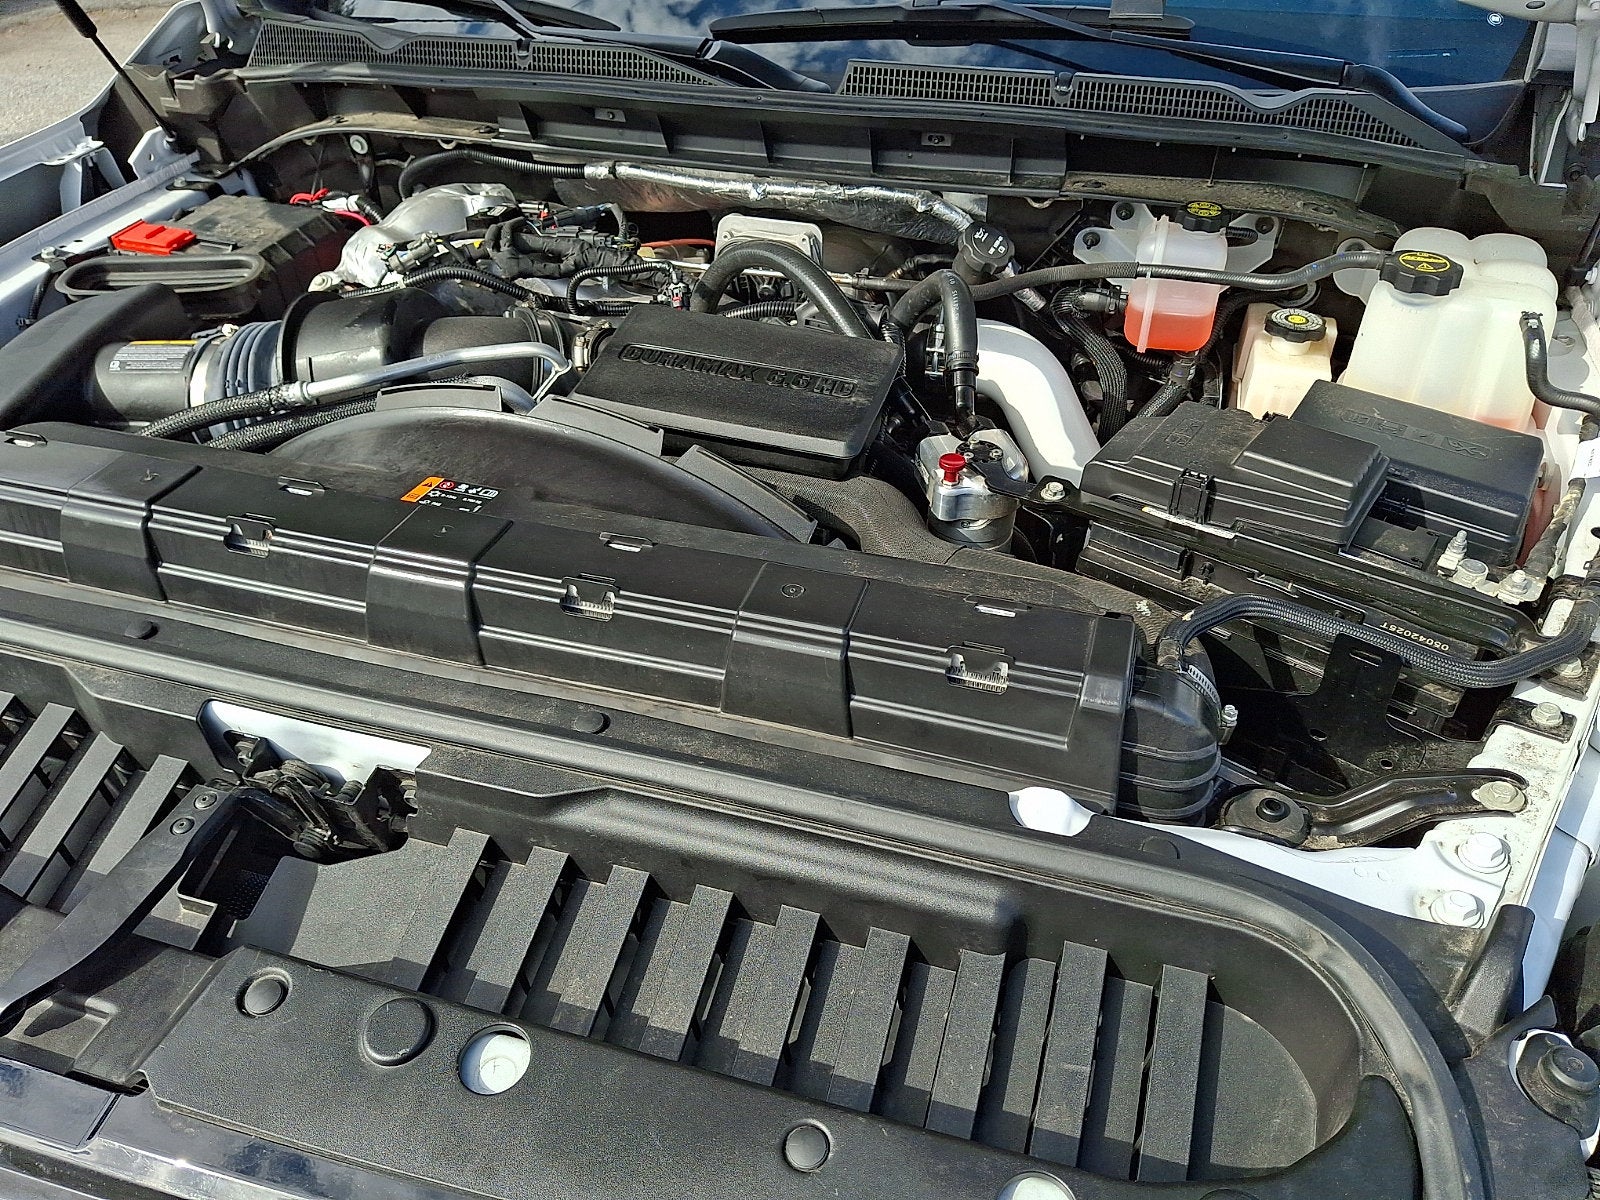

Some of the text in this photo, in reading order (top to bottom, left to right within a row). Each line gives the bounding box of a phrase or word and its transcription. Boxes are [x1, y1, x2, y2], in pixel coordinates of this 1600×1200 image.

[623, 347, 858, 399] DURAMAX 6.6 HD
